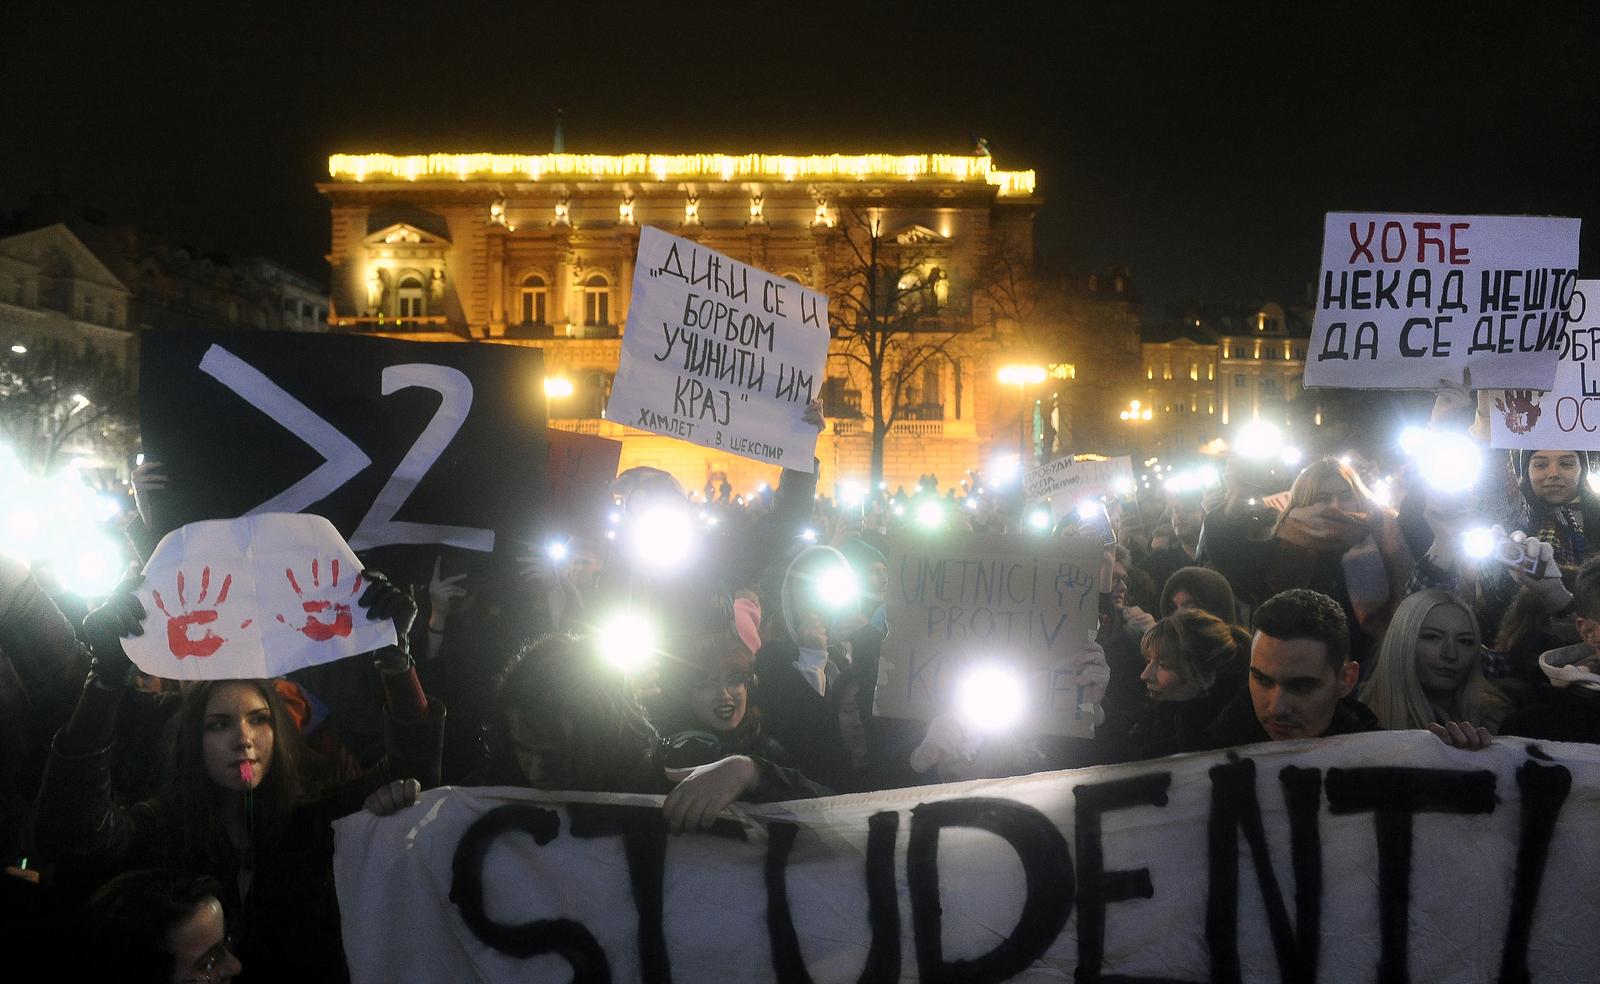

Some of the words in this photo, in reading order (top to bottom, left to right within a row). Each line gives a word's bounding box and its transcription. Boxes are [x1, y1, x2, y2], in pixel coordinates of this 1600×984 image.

[1348, 221, 1471, 265] ХОЋЕ
[762, 279, 787, 318] СЕ
[800, 291, 821, 329] И
[1322, 268, 1469, 314] НЕКАД
[1479, 267, 1580, 314] НЕШТО
[682, 292, 775, 353] БОРБОМ
[1317, 321, 1379, 362] ДА
[1398, 316, 1454, 358] СЕ
[653, 322, 766, 393] УЧИНИТИ
[775, 362, 814, 406] ИМ
[730, 436, 785, 461] ШЕКСПИР
[926, 606, 1068, 650] PROTIV
